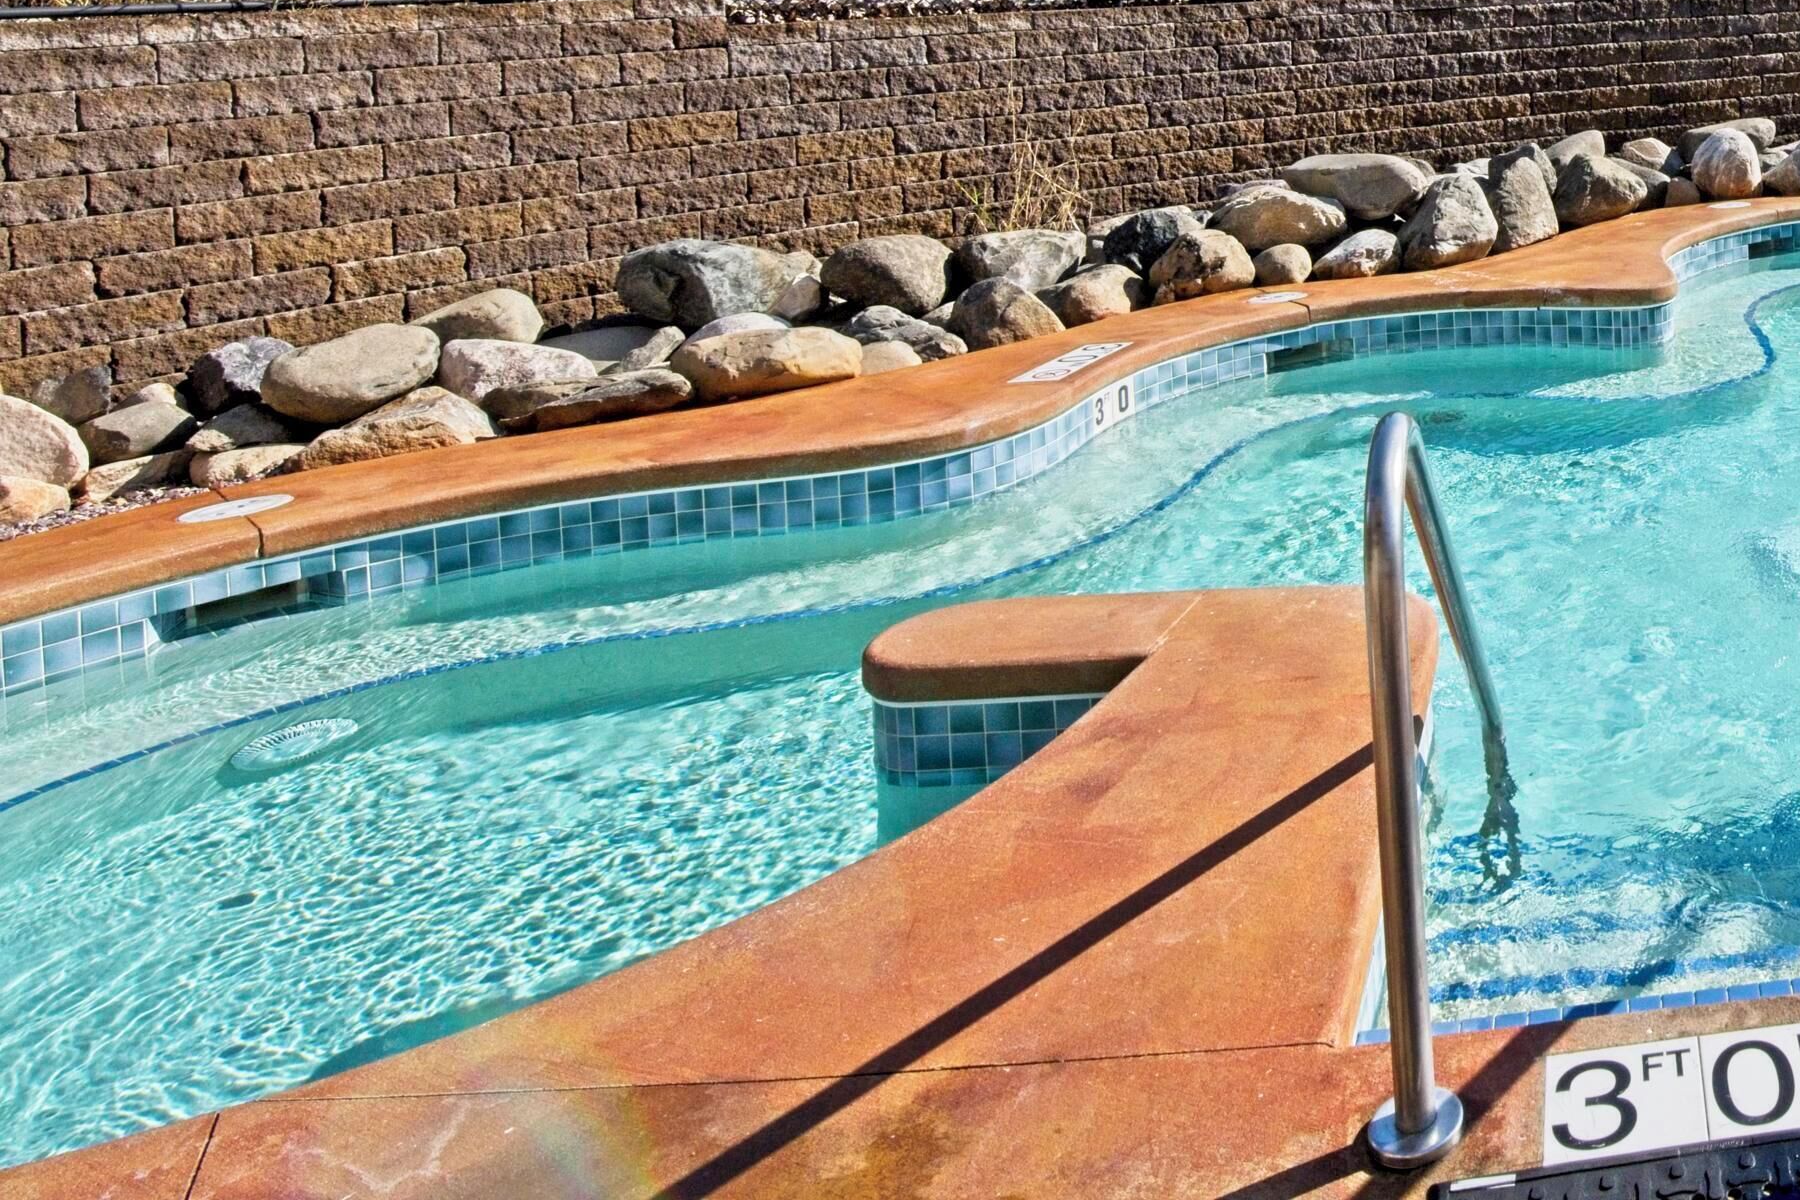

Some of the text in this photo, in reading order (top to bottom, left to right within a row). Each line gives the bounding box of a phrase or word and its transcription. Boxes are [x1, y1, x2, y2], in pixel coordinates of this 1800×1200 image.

[1095, 397, 1104, 425] 3
[1118, 385, 1129, 412] 0
[1551, 1059, 1638, 1151] 3
[1642, 1048, 1691, 1082] FT
[1711, 1039, 1796, 1127] 0
